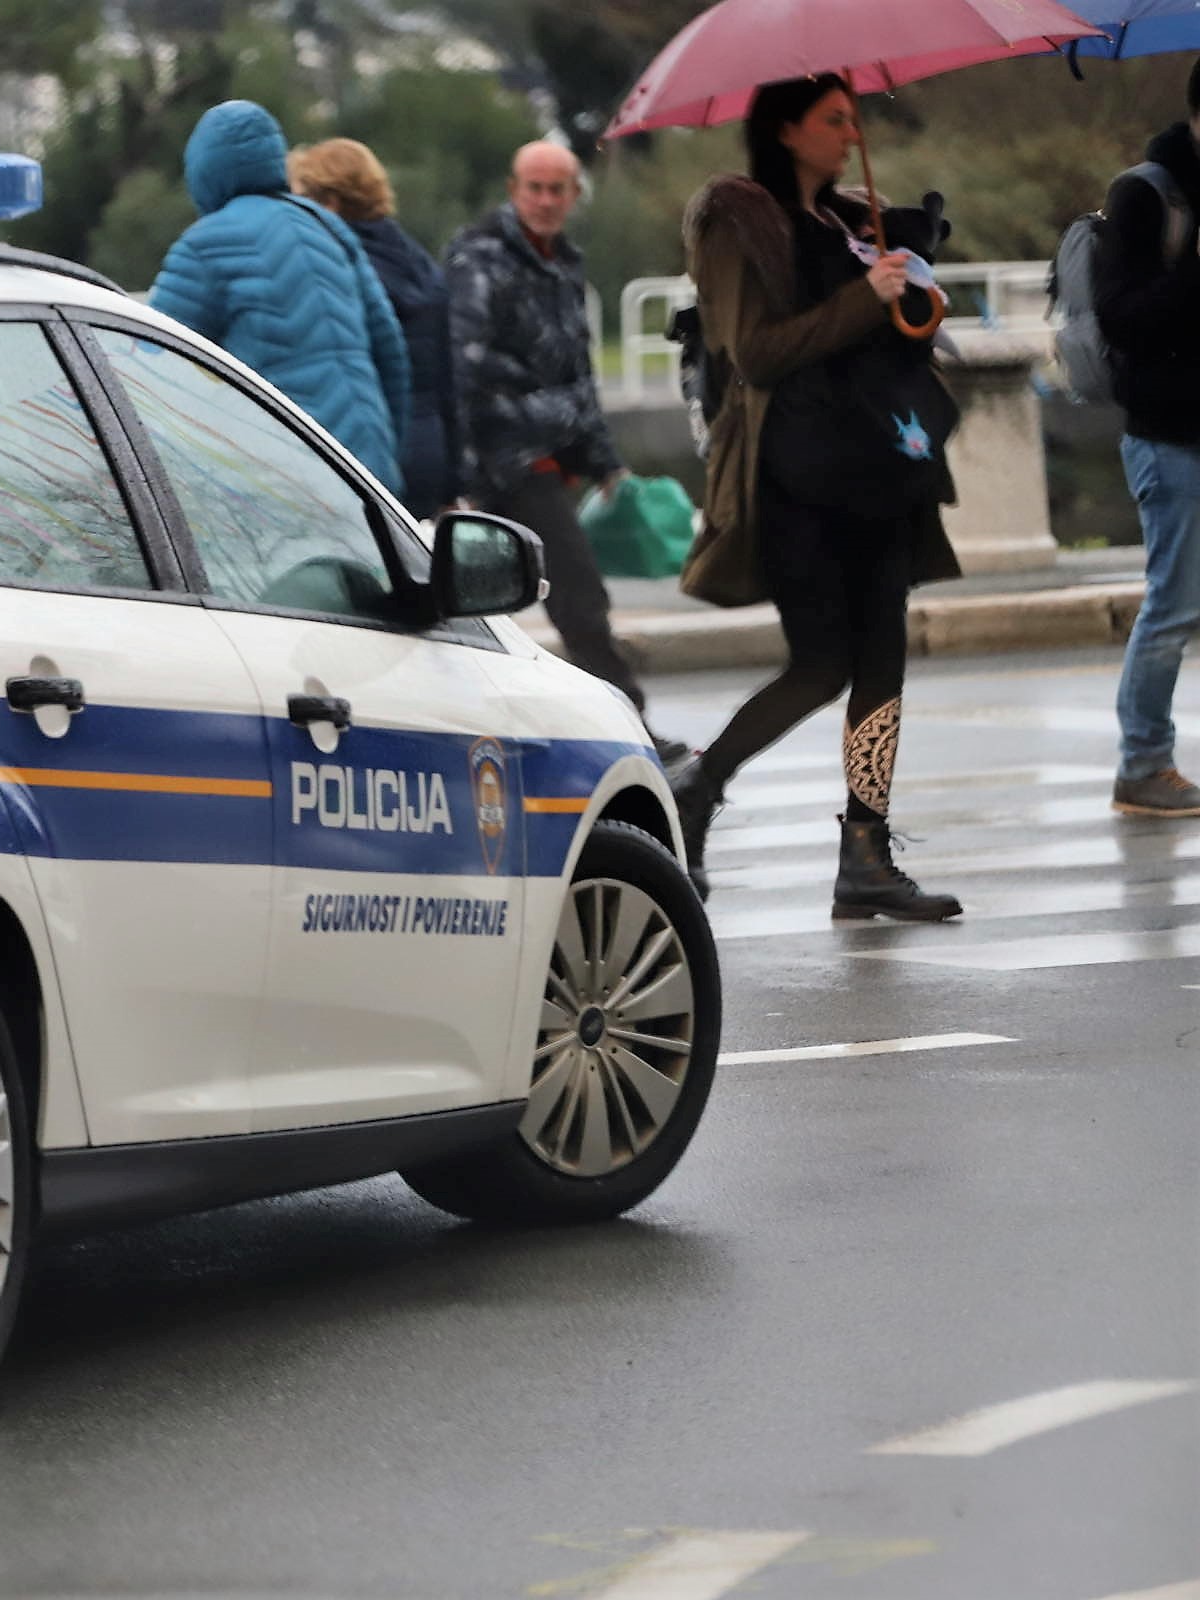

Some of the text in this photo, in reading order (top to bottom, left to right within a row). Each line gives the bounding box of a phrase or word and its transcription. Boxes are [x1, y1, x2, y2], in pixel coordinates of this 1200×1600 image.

[291, 760, 453, 835] POLICIJA
[302, 894, 508, 936] SIGURNOST I POVJERENJE
